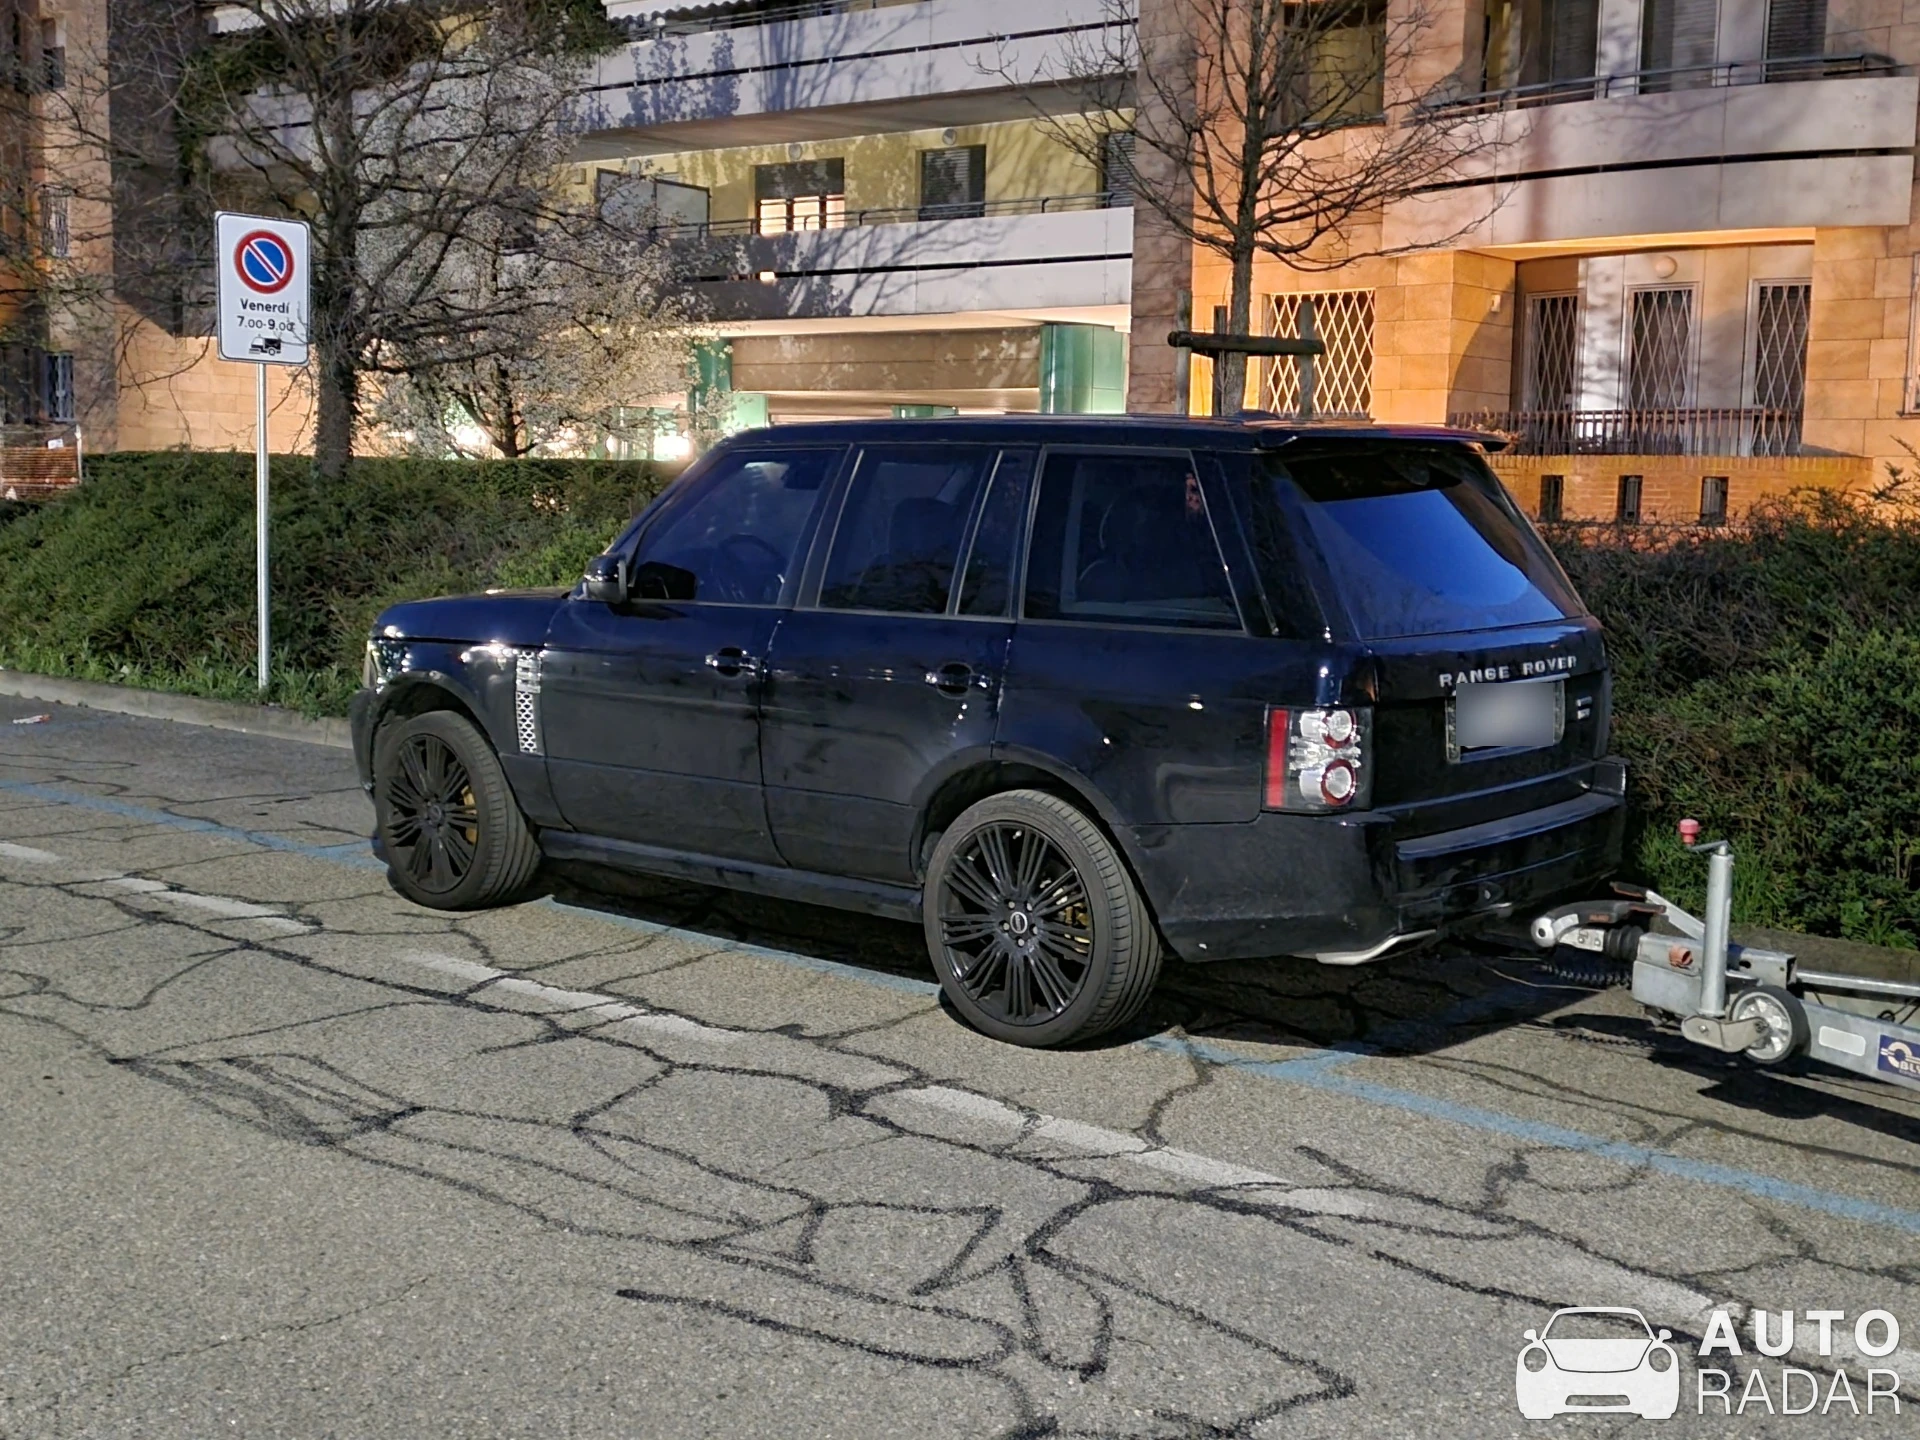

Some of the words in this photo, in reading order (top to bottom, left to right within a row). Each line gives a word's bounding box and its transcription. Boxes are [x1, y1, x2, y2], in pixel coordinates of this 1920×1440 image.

[237, 315, 294, 331] 7.00-9.00
[1439, 665, 1510, 688] RANGE
[1523, 655, 1577, 676] ROVER
